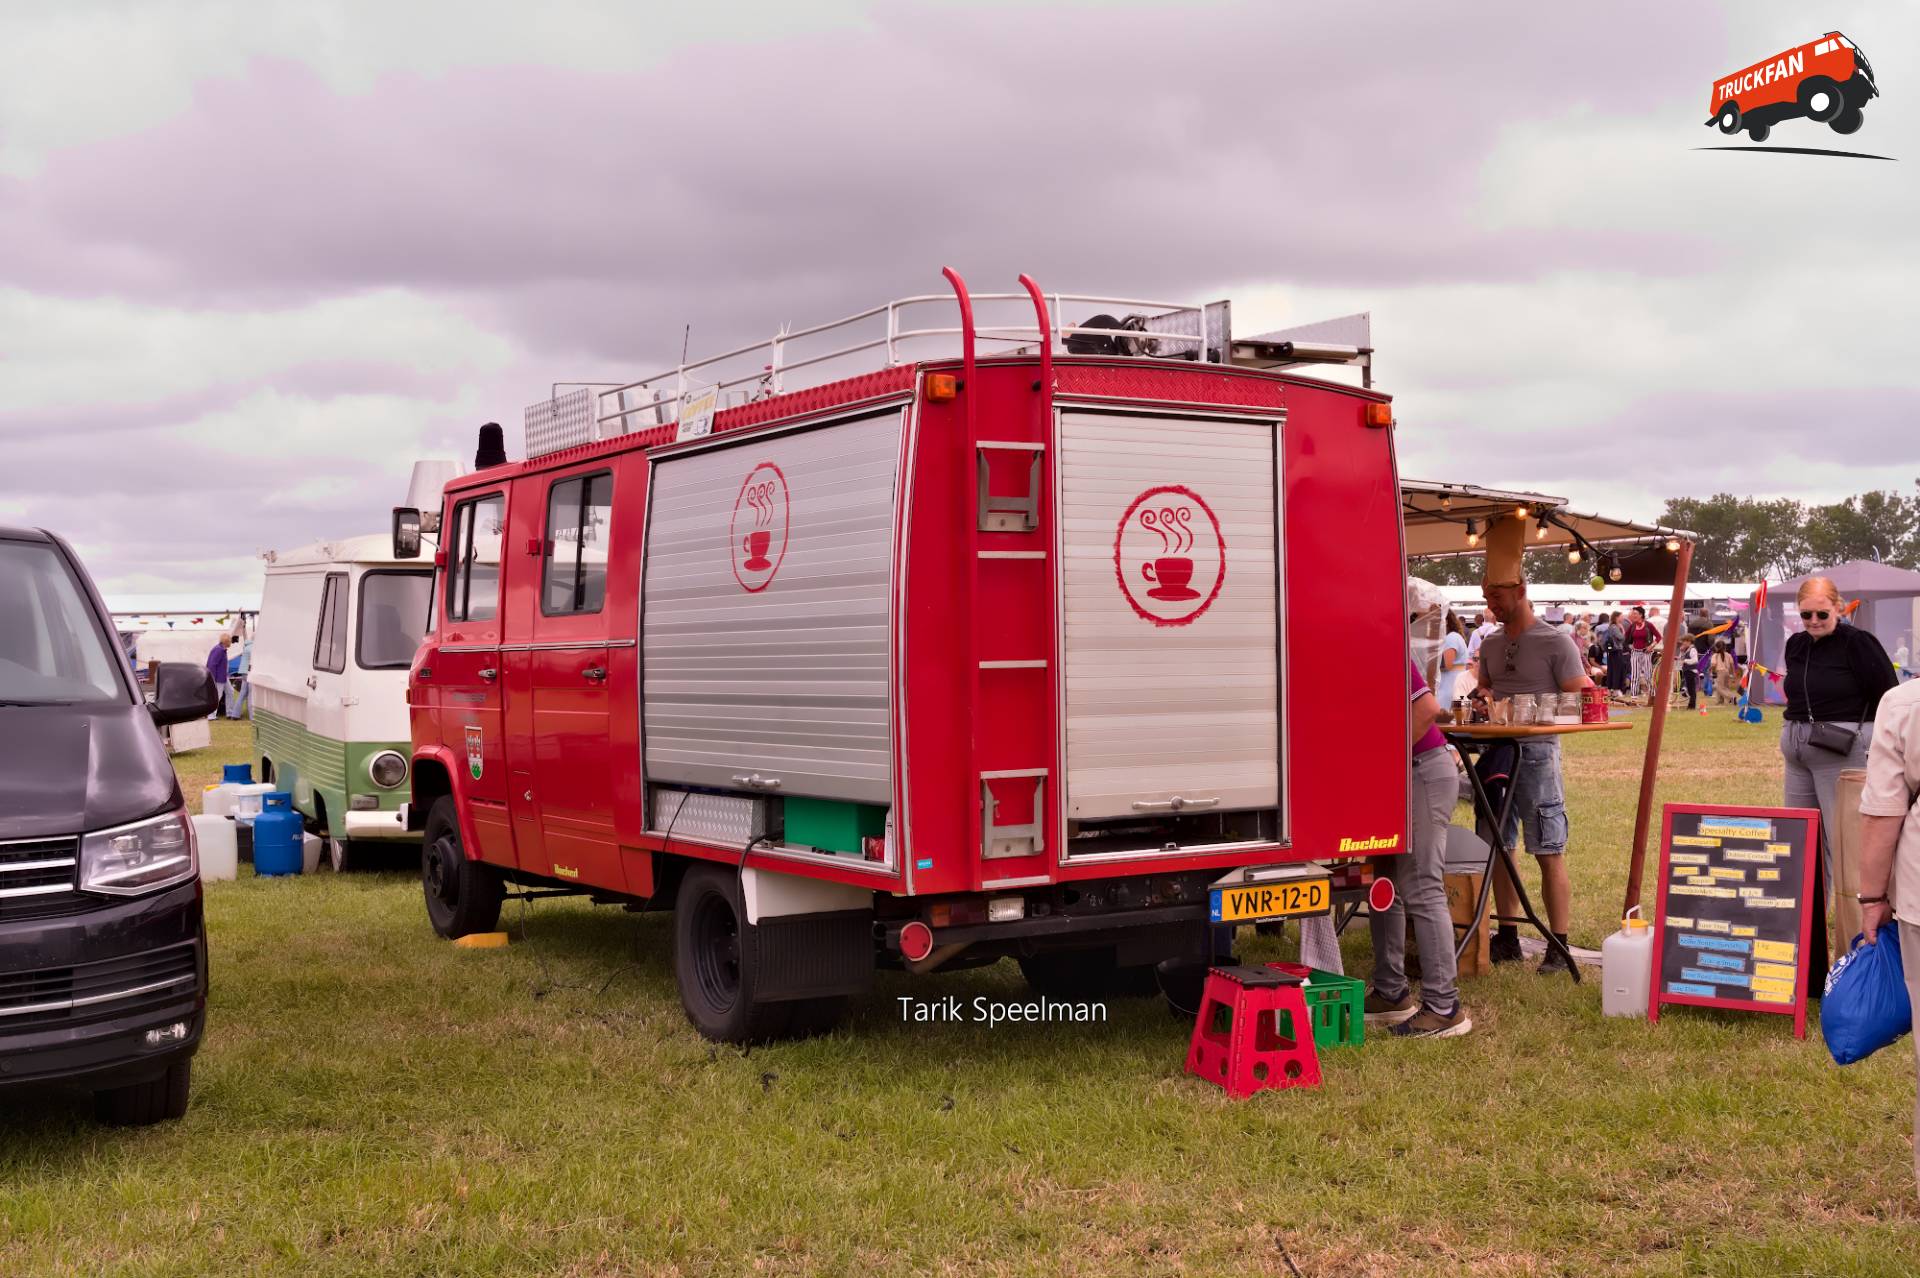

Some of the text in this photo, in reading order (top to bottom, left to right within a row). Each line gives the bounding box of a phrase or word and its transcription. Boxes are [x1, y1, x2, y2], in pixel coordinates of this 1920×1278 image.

[1700, 826, 1767, 838] Specialty Coffee
[1231, 885, 1322, 915] VNR-12-D
[1211, 909, 1221, 917] NL
